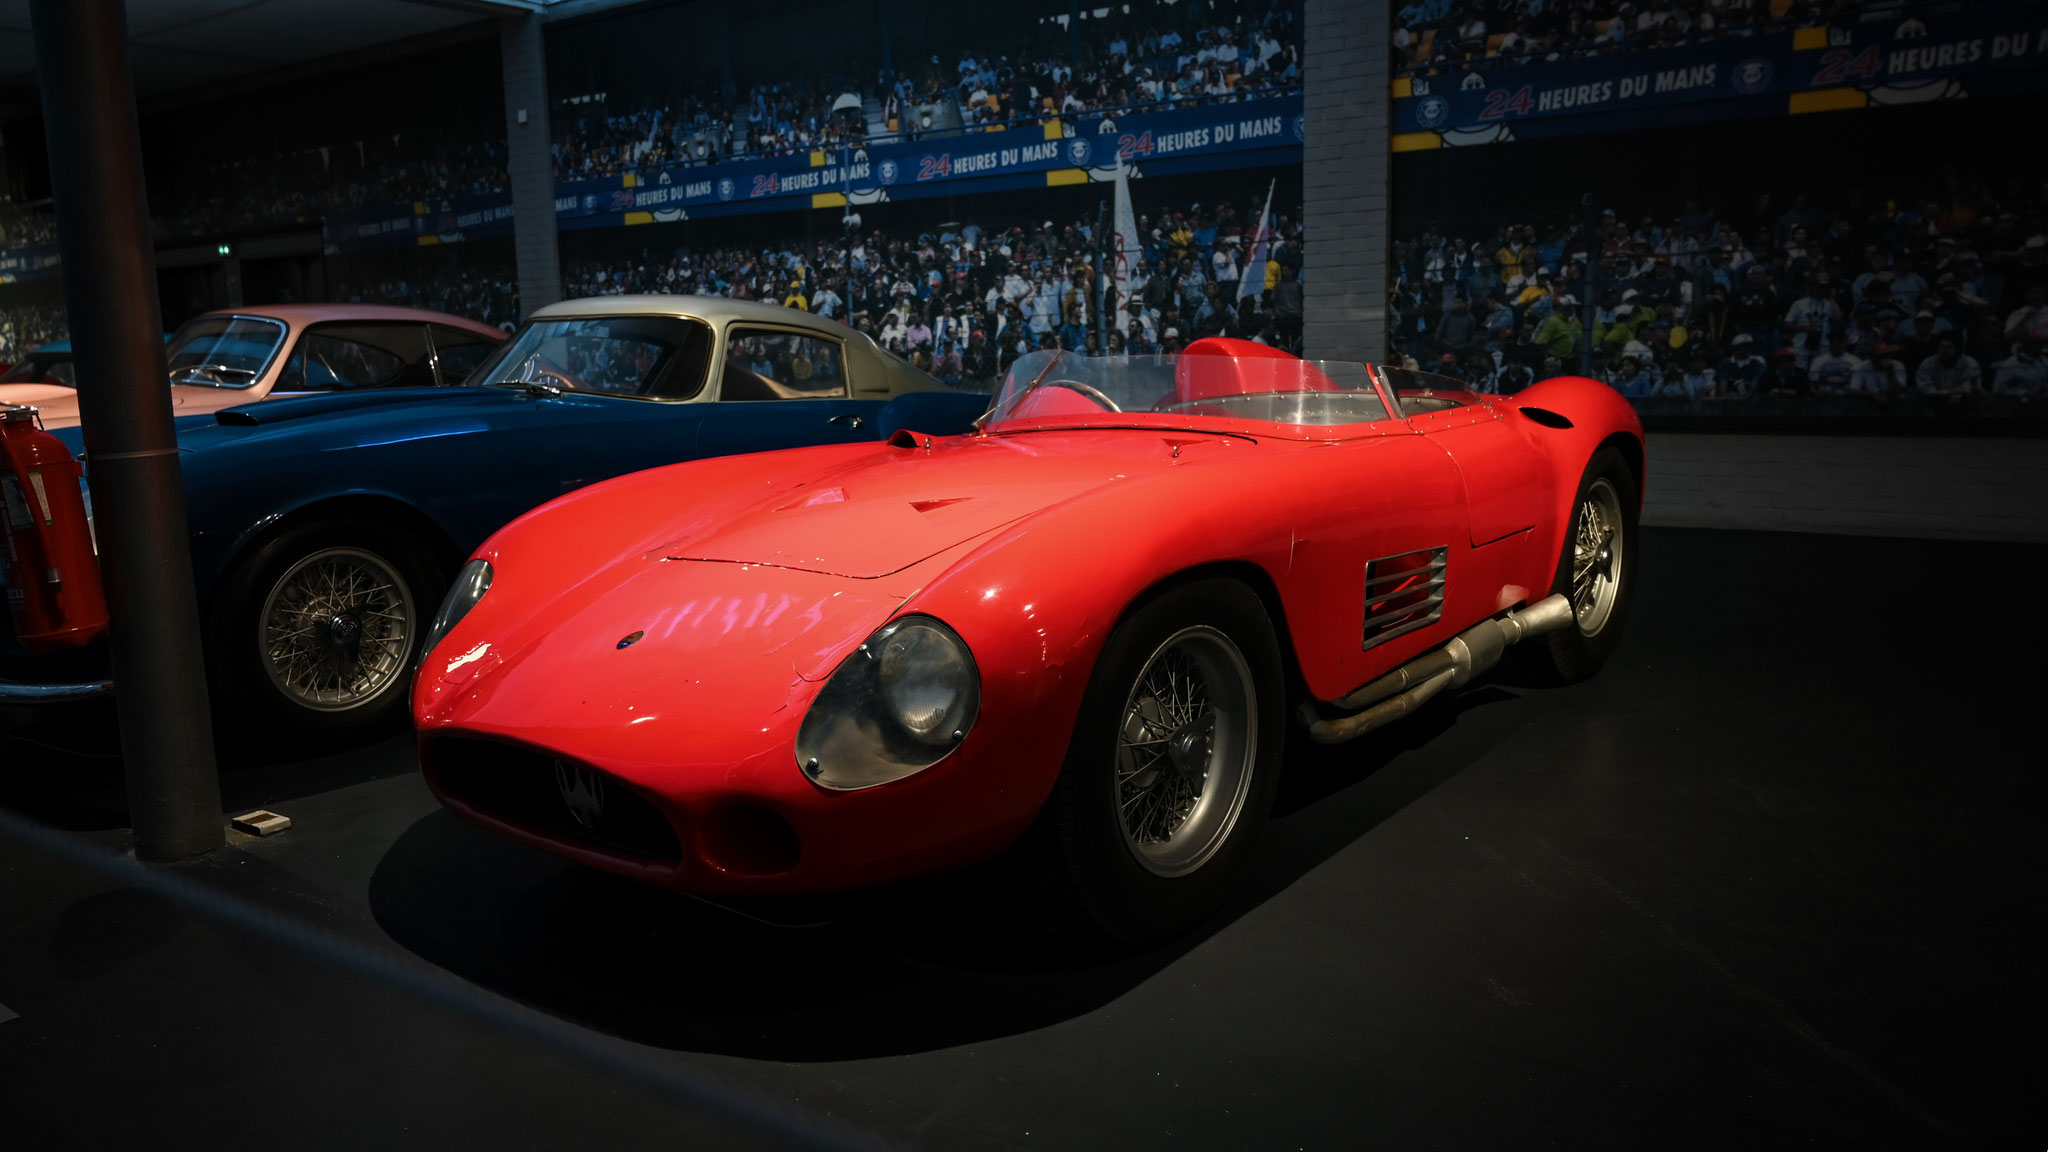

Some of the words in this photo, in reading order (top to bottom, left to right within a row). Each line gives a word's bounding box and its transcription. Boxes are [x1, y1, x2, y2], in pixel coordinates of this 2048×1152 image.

[1810, 44, 1883, 86] 24
[1888, 39, 1982, 74] HEURES
[1991, 31, 2030, 59] DU
[1479, 84, 1535, 121] 24
[1538, 82, 1612, 112] HEURES
[1619, 75, 1649, 99] DU
[1654, 63, 1717, 93] MANS
[1117, 130, 1155, 159] 24
[1157, 128, 1209, 153] HEURES
[1214, 123, 1234, 144] DU
[1239, 116, 1282, 140] MANS
[917, 153, 952, 181] 24
[953, 152, 997, 175] HEURES
[1001, 148, 1018, 167] DU
[1022, 141, 1058, 163] MANS
[609, 188, 635, 212] 24
[636, 188, 668, 207] HEURES
[670, 185, 683, 201] DU
[686, 180, 712, 198] MANS
[750, 172, 780, 197] 24
[781, 171, 819, 192] HEURES
[822, 168, 837, 184] DU
